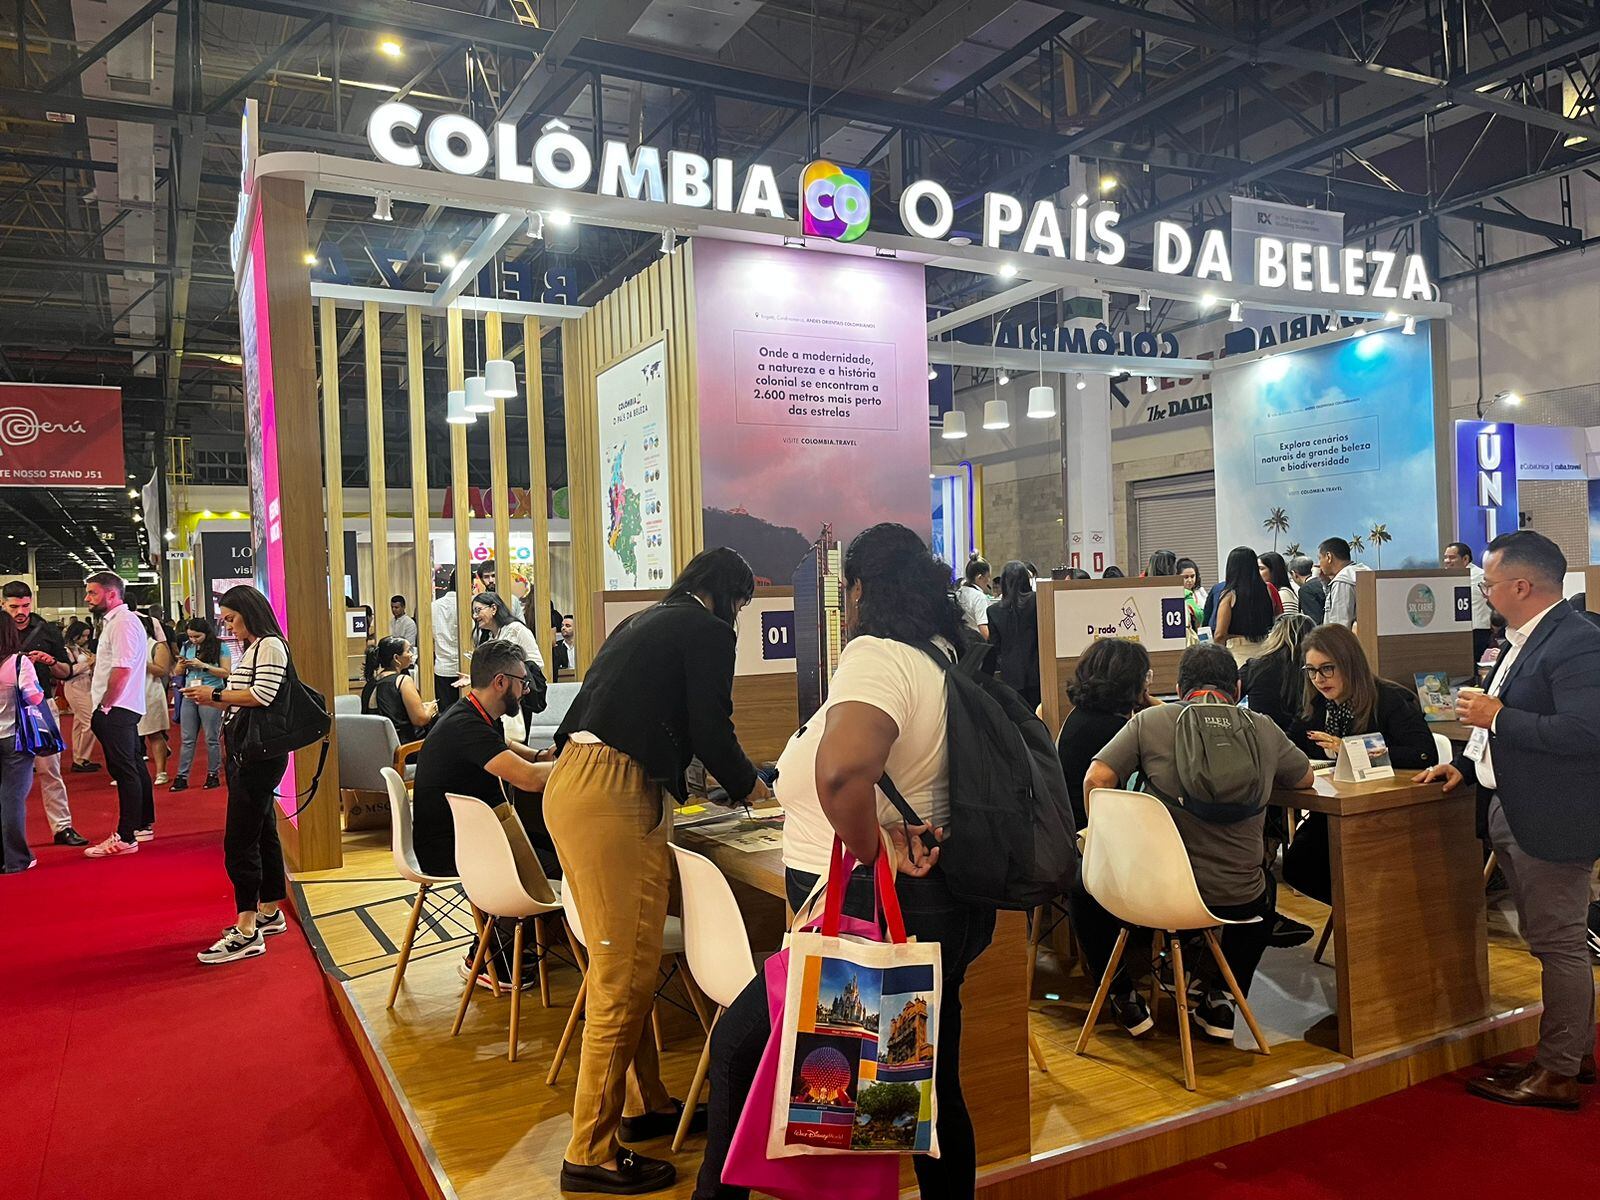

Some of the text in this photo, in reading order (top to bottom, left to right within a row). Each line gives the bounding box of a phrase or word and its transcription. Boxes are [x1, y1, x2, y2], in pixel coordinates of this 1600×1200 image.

[367, 102, 785, 219] COLÔMBIA
[804, 178, 871, 226] CO
[1257, 212, 1272, 224] RX
[900, 180, 1435, 300] O PAÍS DA BELEZA
[759, 347, 789, 358] Onde
[802, 352, 874, 366] modernidade,
[769, 363, 816, 374] natureza
[839, 366, 876, 378] história
[756, 375, 797, 387] colonial
[815, 381, 869, 392] encontram
[754, 389, 882, 407] 2.600 metros mais perto
[788, 405, 850, 417] das estrelas
[1147, 405, 1166, 422] The
[801, 438, 857, 446] COLOMBIA.TRAVEL
[1280, 434, 1349, 452] Explora cenários
[1262, 442, 1371, 464] naturais de grande beleza
[1288, 456, 1350, 471] biodiversidade
[1301, 486, 1342, 495] COLOMBIA.TRAVEL
[1458, 598, 1469, 610] 05
[1166, 612, 1181, 626] 03
[768, 627, 788, 644] 01
[1204, 717, 1231, 726] PIER
[807, 1130, 828, 1140] Disney
